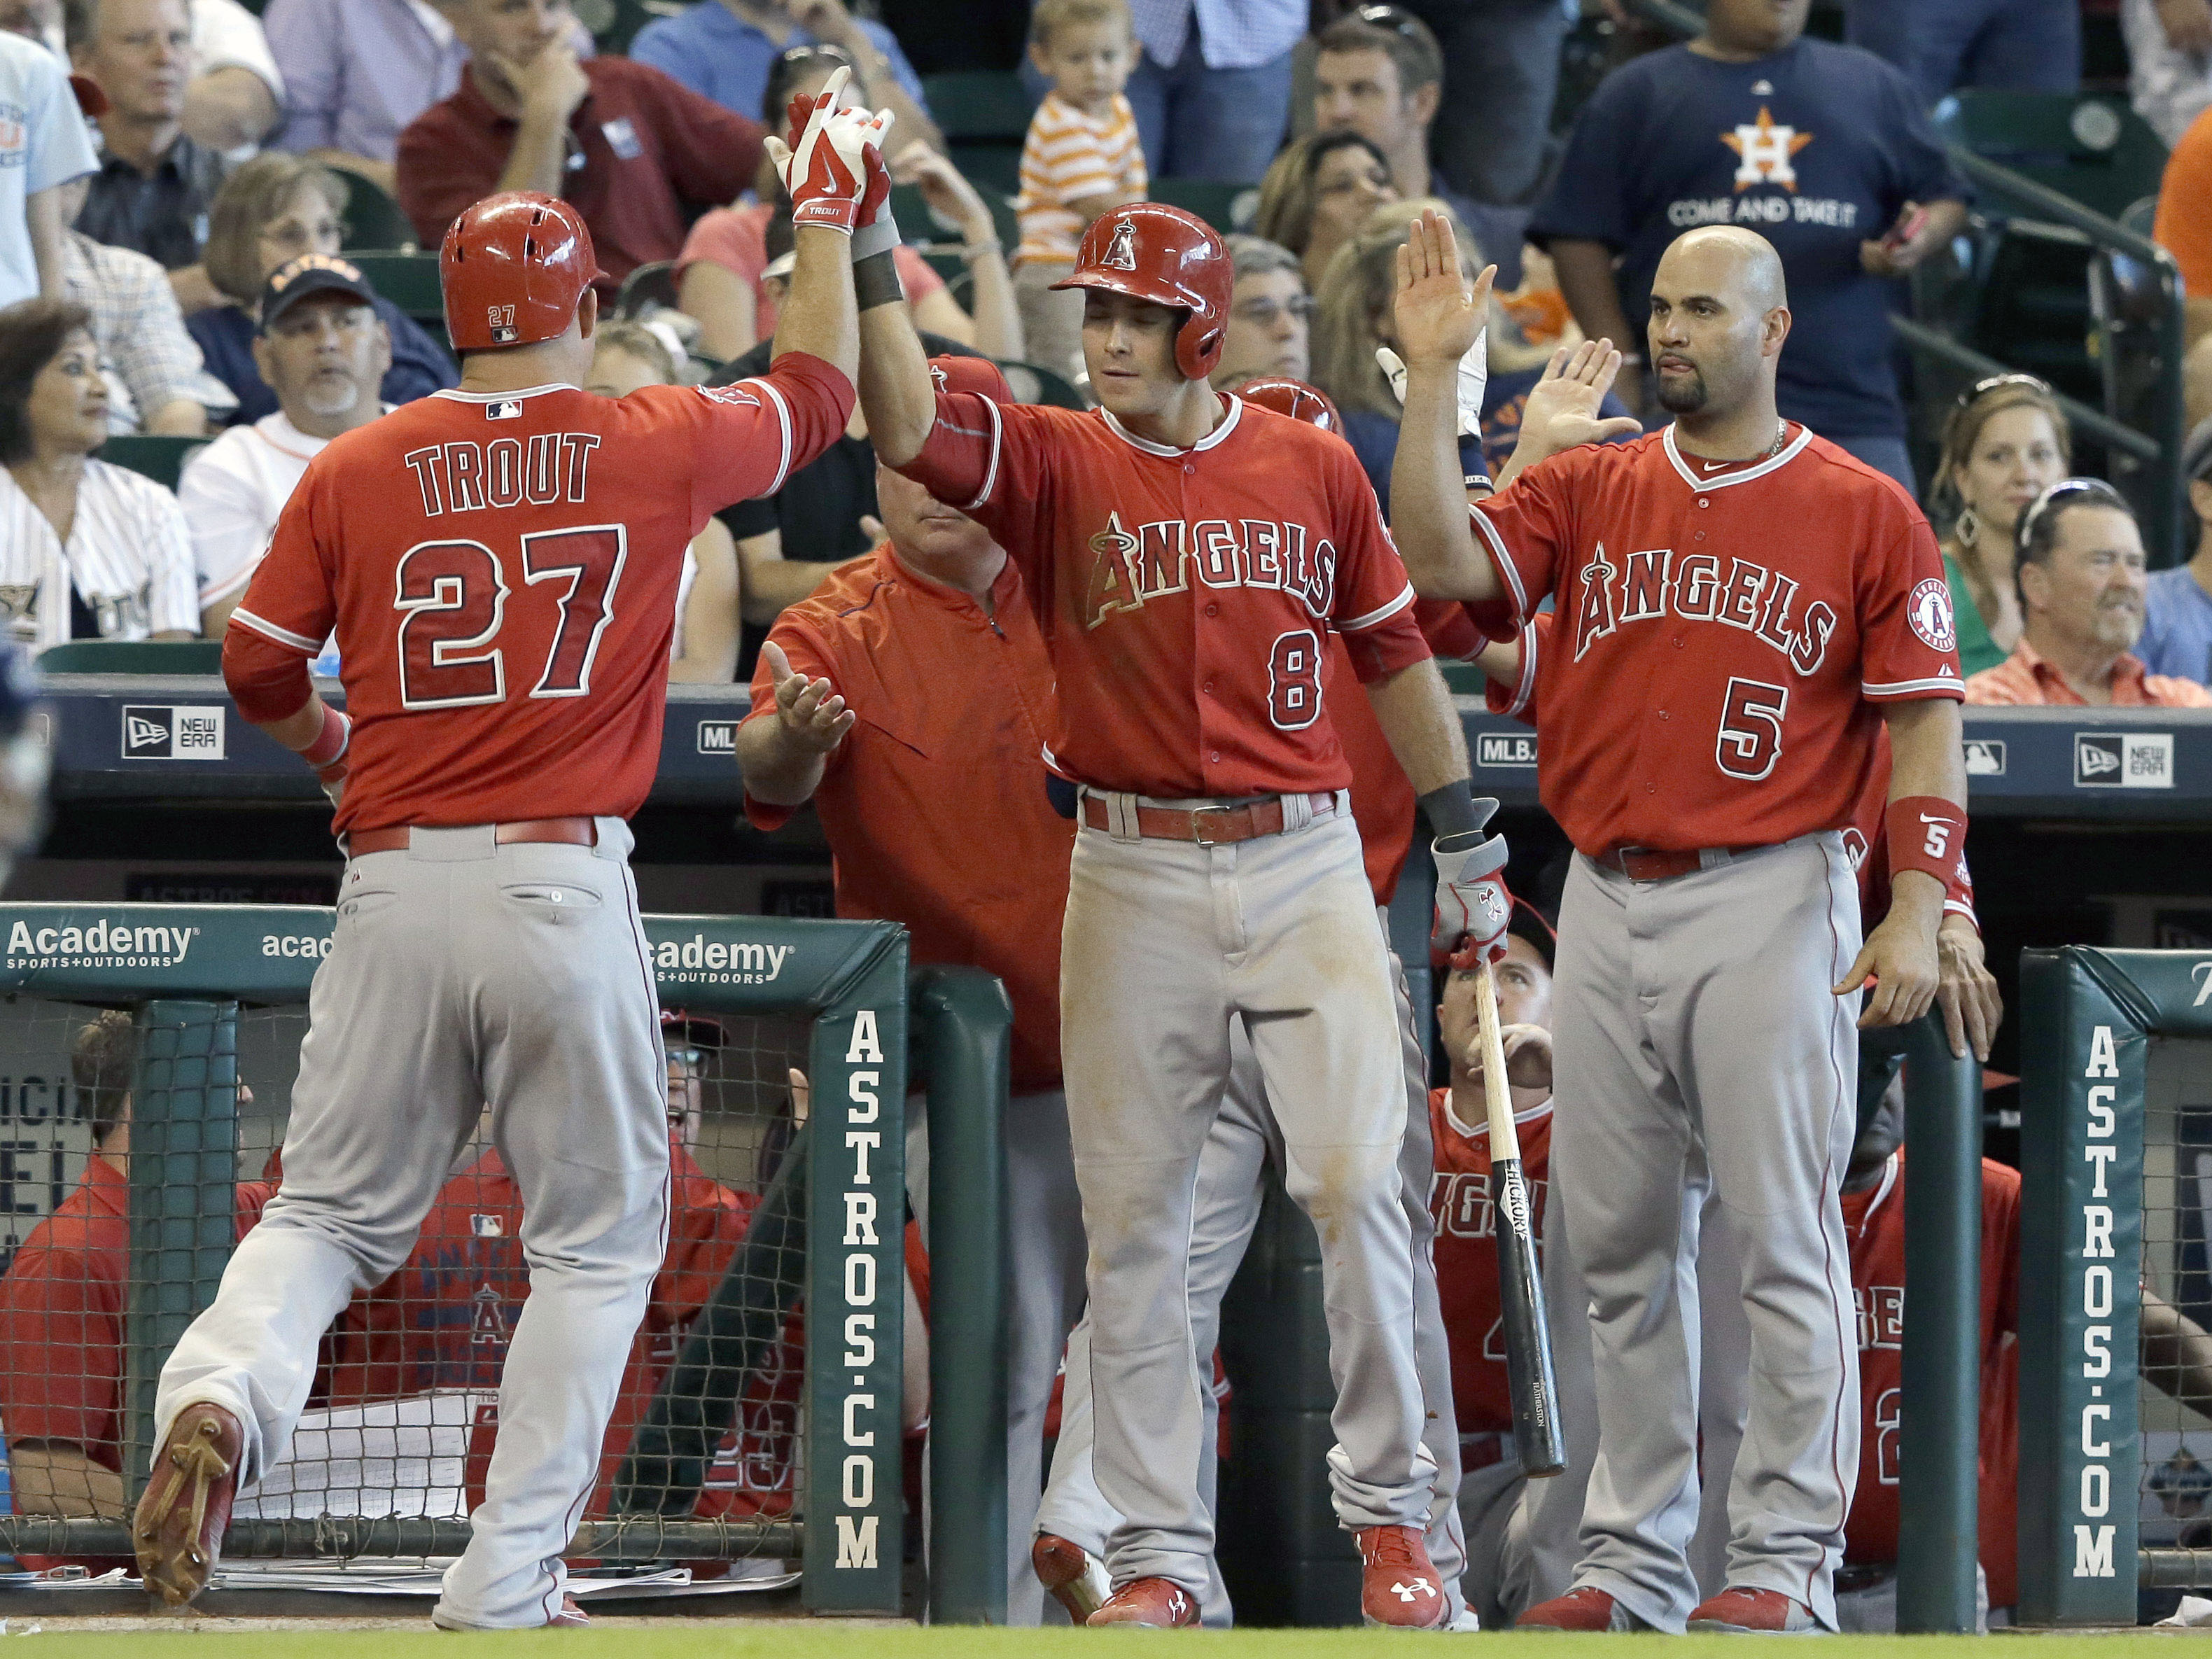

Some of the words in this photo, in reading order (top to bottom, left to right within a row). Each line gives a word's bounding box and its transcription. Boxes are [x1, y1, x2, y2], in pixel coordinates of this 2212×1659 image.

[1734, 124, 1796, 183] H
[809, 206, 841, 216] TROUT
[1733, 195, 1789, 223] AND
[488, 304, 515, 327] 27
[404, 432, 601, 517] TROUT
[1086, 510, 1336, 629] ANGELS
[393, 522, 628, 710] 27
[1573, 540, 1837, 676] ANGELS
[1267, 629, 1323, 731] 8
[181, 718, 216, 732] NEW
[181, 733, 216, 747] ERA
[1715, 676, 1788, 781] 5
[1484, 739, 1537, 762] MLB.
[1923, 823, 1949, 859] 5
[653, 971, 764, 985] S+OUTDOORS
[1507, 1170, 1528, 1236] HICKORY
